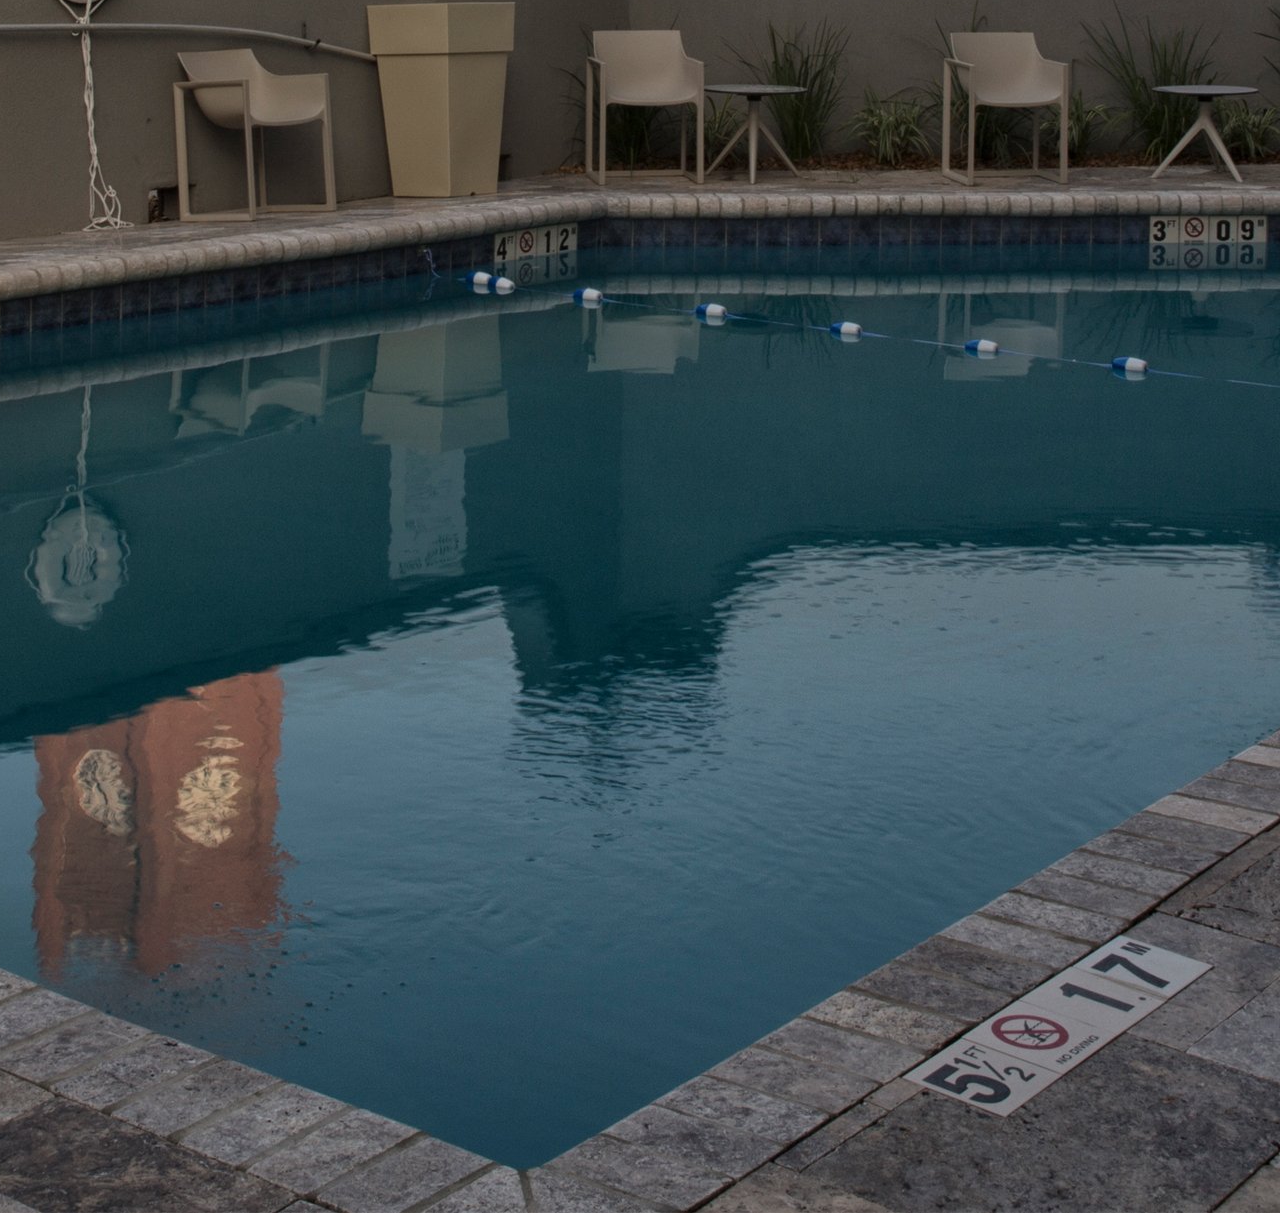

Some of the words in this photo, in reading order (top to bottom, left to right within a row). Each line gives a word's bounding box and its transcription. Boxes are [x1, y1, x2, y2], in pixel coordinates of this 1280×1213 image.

[1153, 220, 1166, 241] 3
[497, 237, 507, 260] 4
[1120, 941, 1151, 956] M
[963, 1045, 988, 1060] FT
[1056, 1053, 1074, 1066] NO
[1070, 1034, 1100, 1057] DIVING
